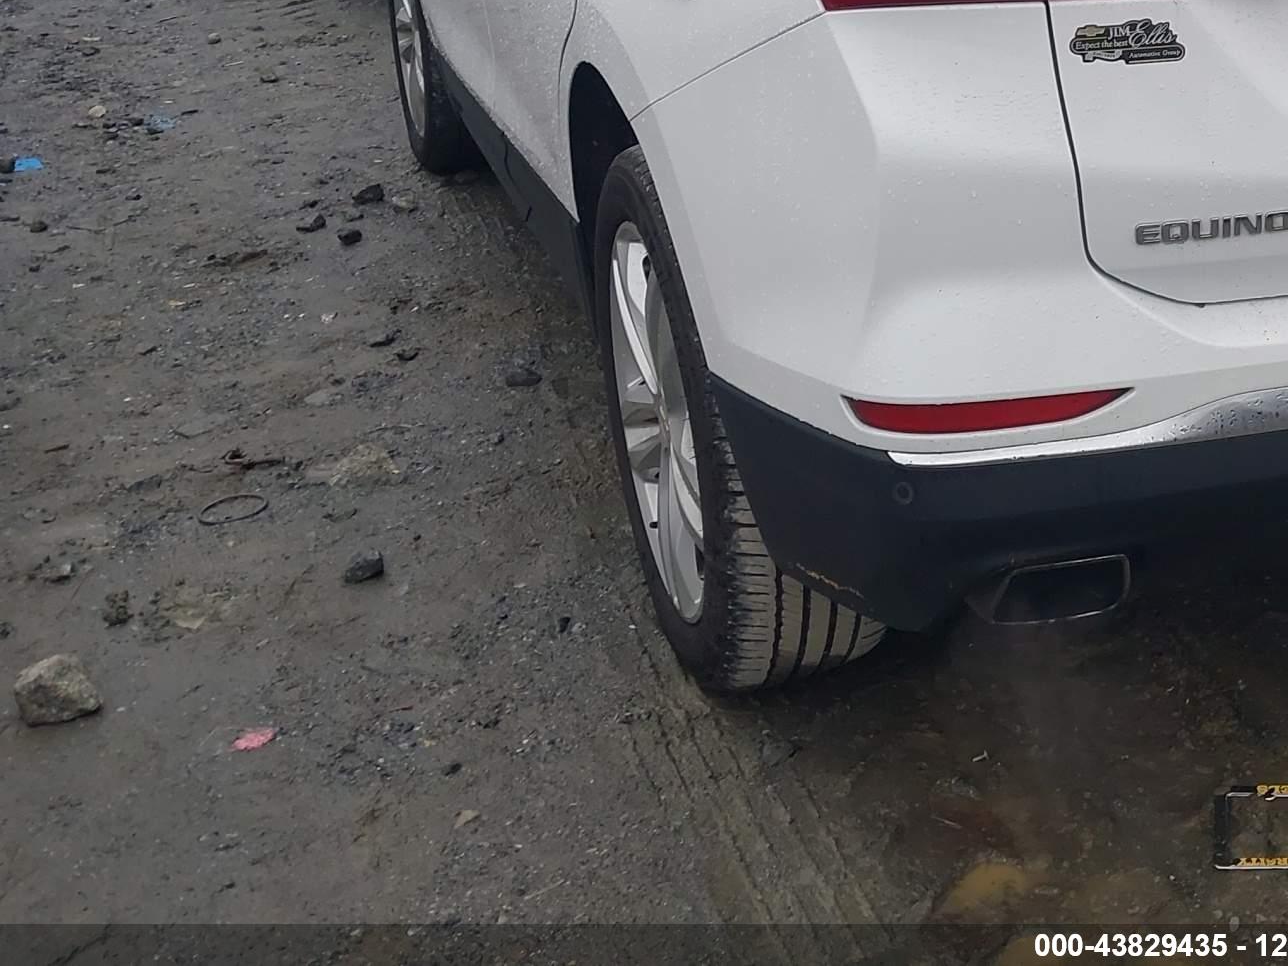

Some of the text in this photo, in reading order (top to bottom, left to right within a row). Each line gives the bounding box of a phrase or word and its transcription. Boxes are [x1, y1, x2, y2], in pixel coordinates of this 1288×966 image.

[1108, 20, 1177, 48] JIM Ellis
[1075, 39, 1128, 51] Expect the best
